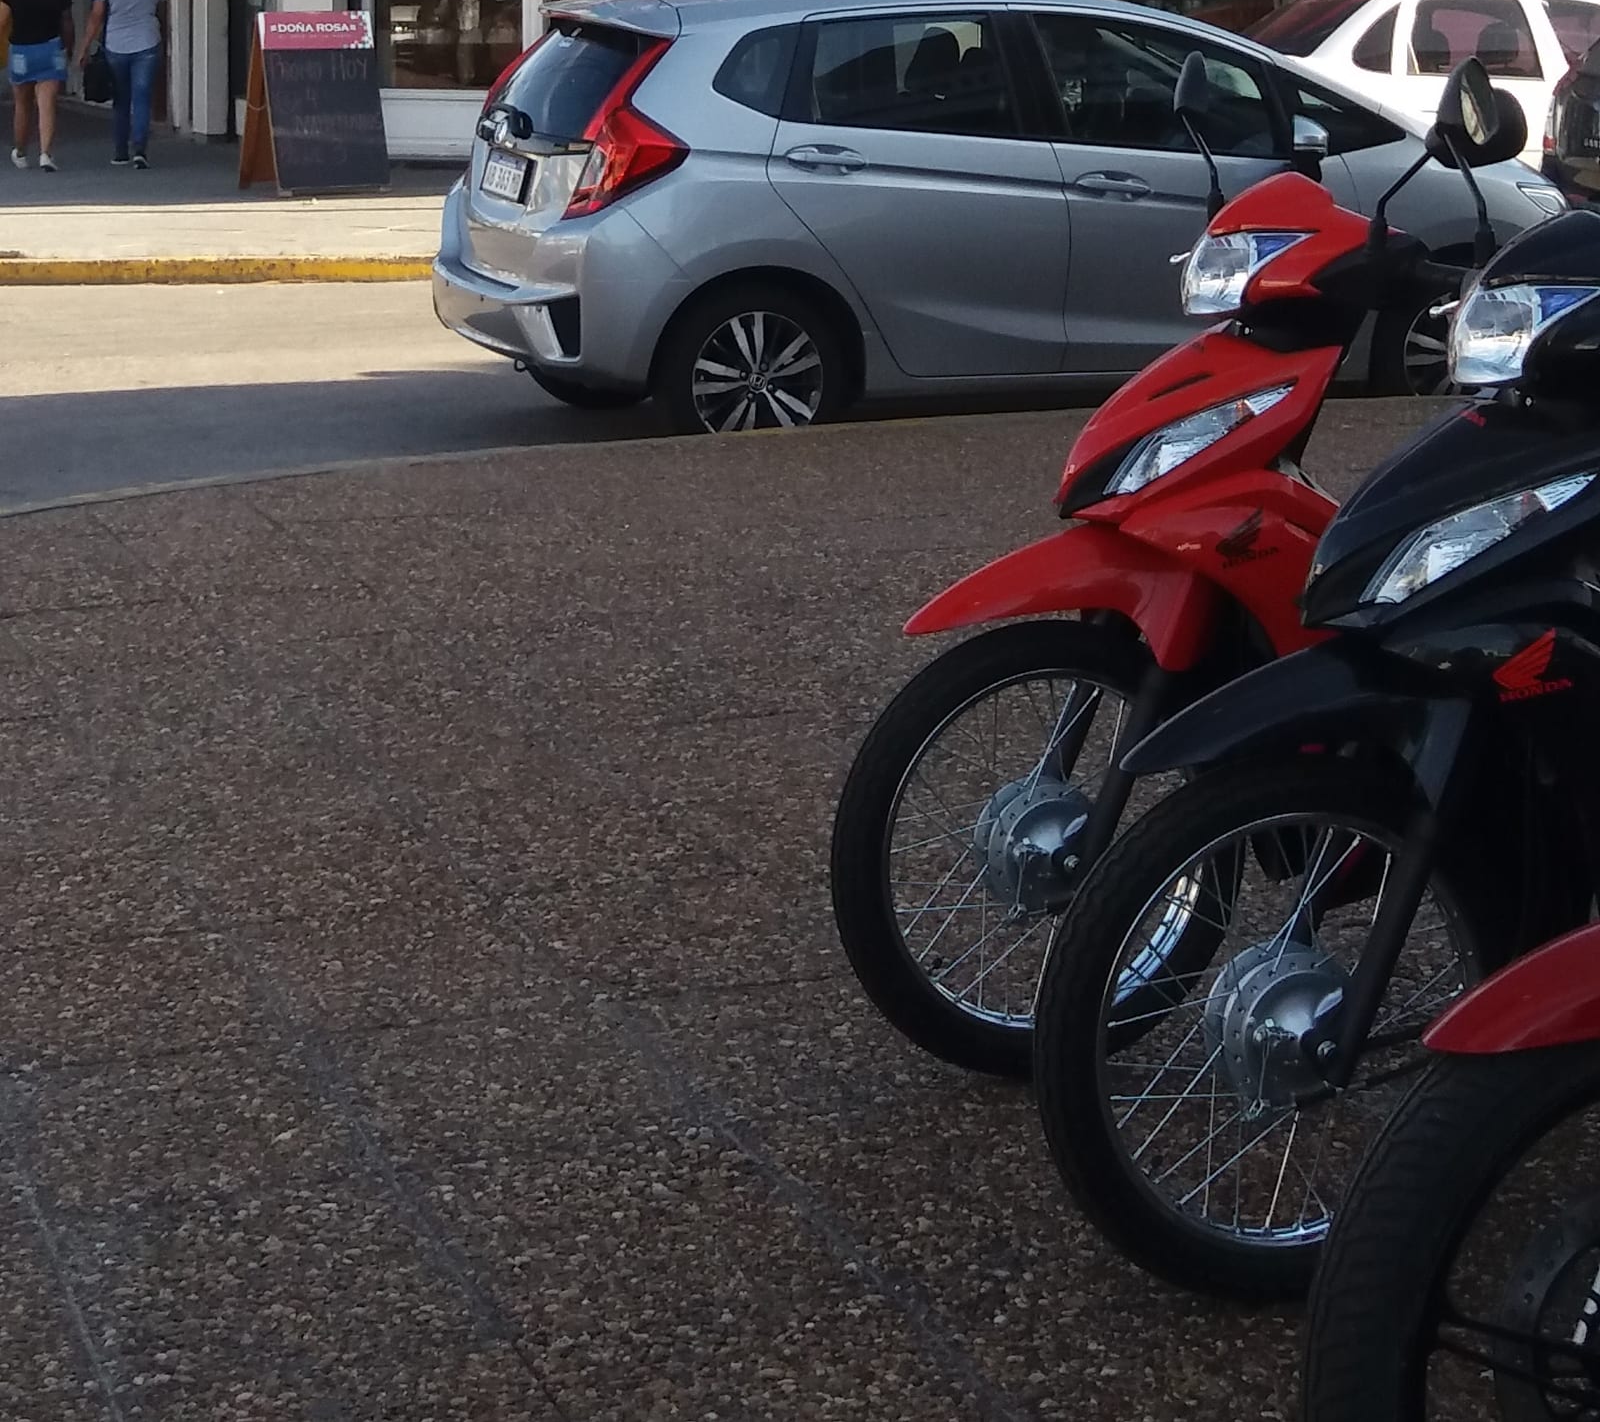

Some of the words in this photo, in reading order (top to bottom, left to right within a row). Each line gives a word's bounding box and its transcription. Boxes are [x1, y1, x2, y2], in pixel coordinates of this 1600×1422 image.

[278, 21, 313, 32] DOÑA
[316, 22, 350, 32] ROSA
[1500, 679, 1573, 702] HONDA
